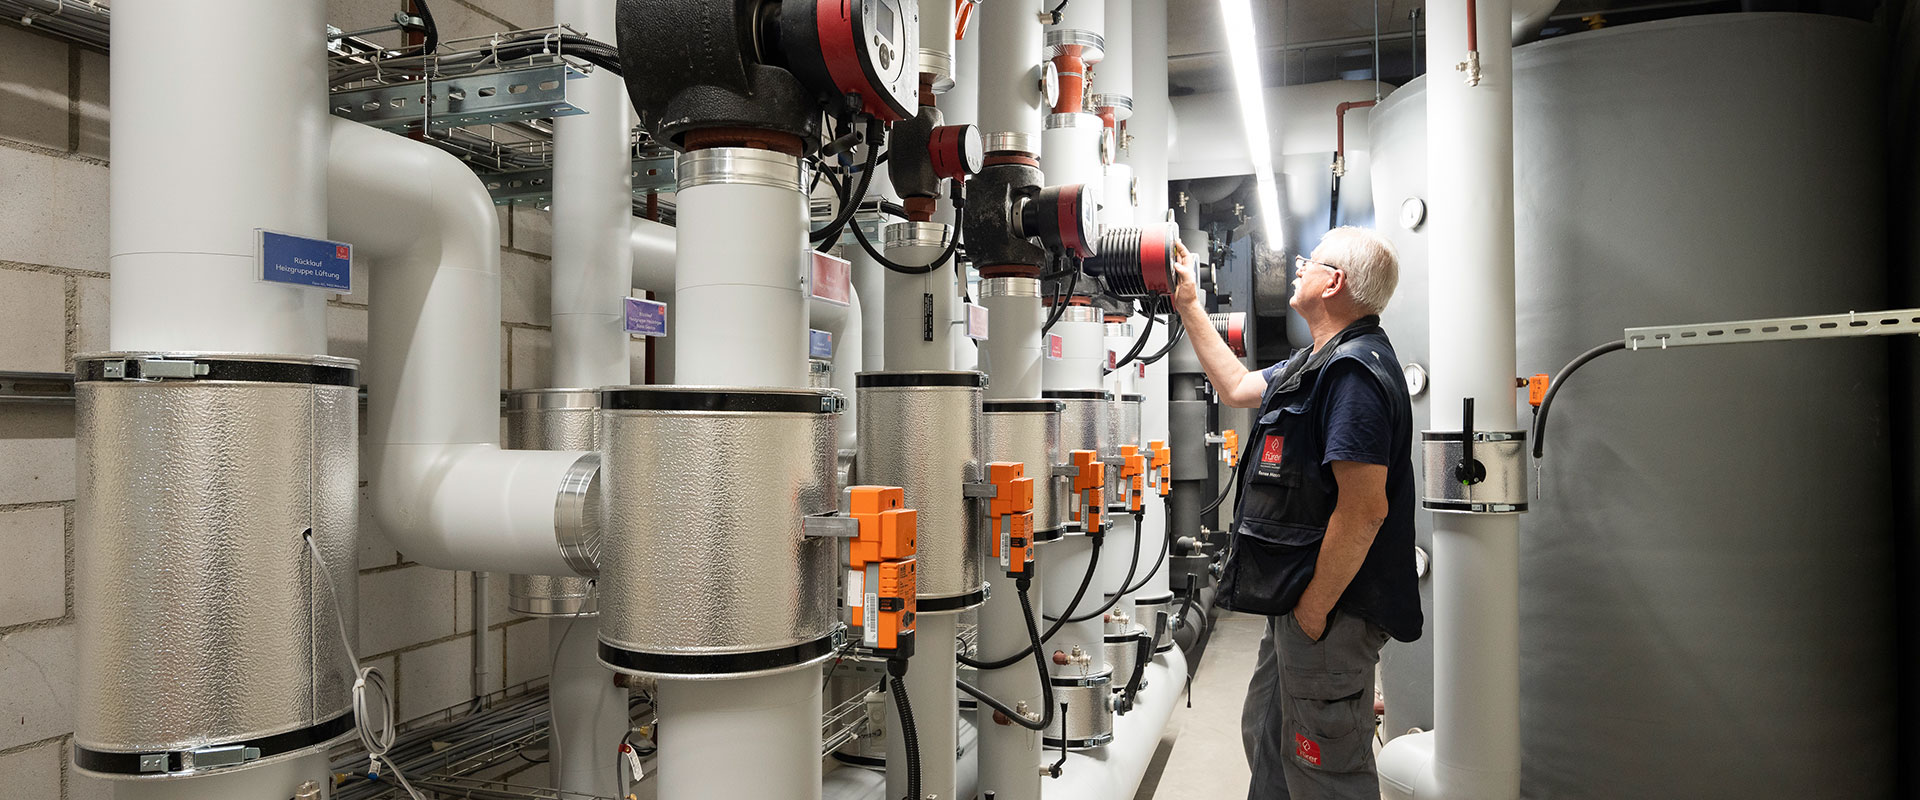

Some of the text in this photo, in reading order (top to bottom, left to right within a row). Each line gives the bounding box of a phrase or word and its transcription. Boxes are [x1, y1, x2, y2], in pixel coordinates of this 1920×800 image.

[294, 257, 322, 267] Rücklauf
[275, 264, 340, 280] Heizgruppe Lüftung
[1264, 450, 1282, 461] fürer
